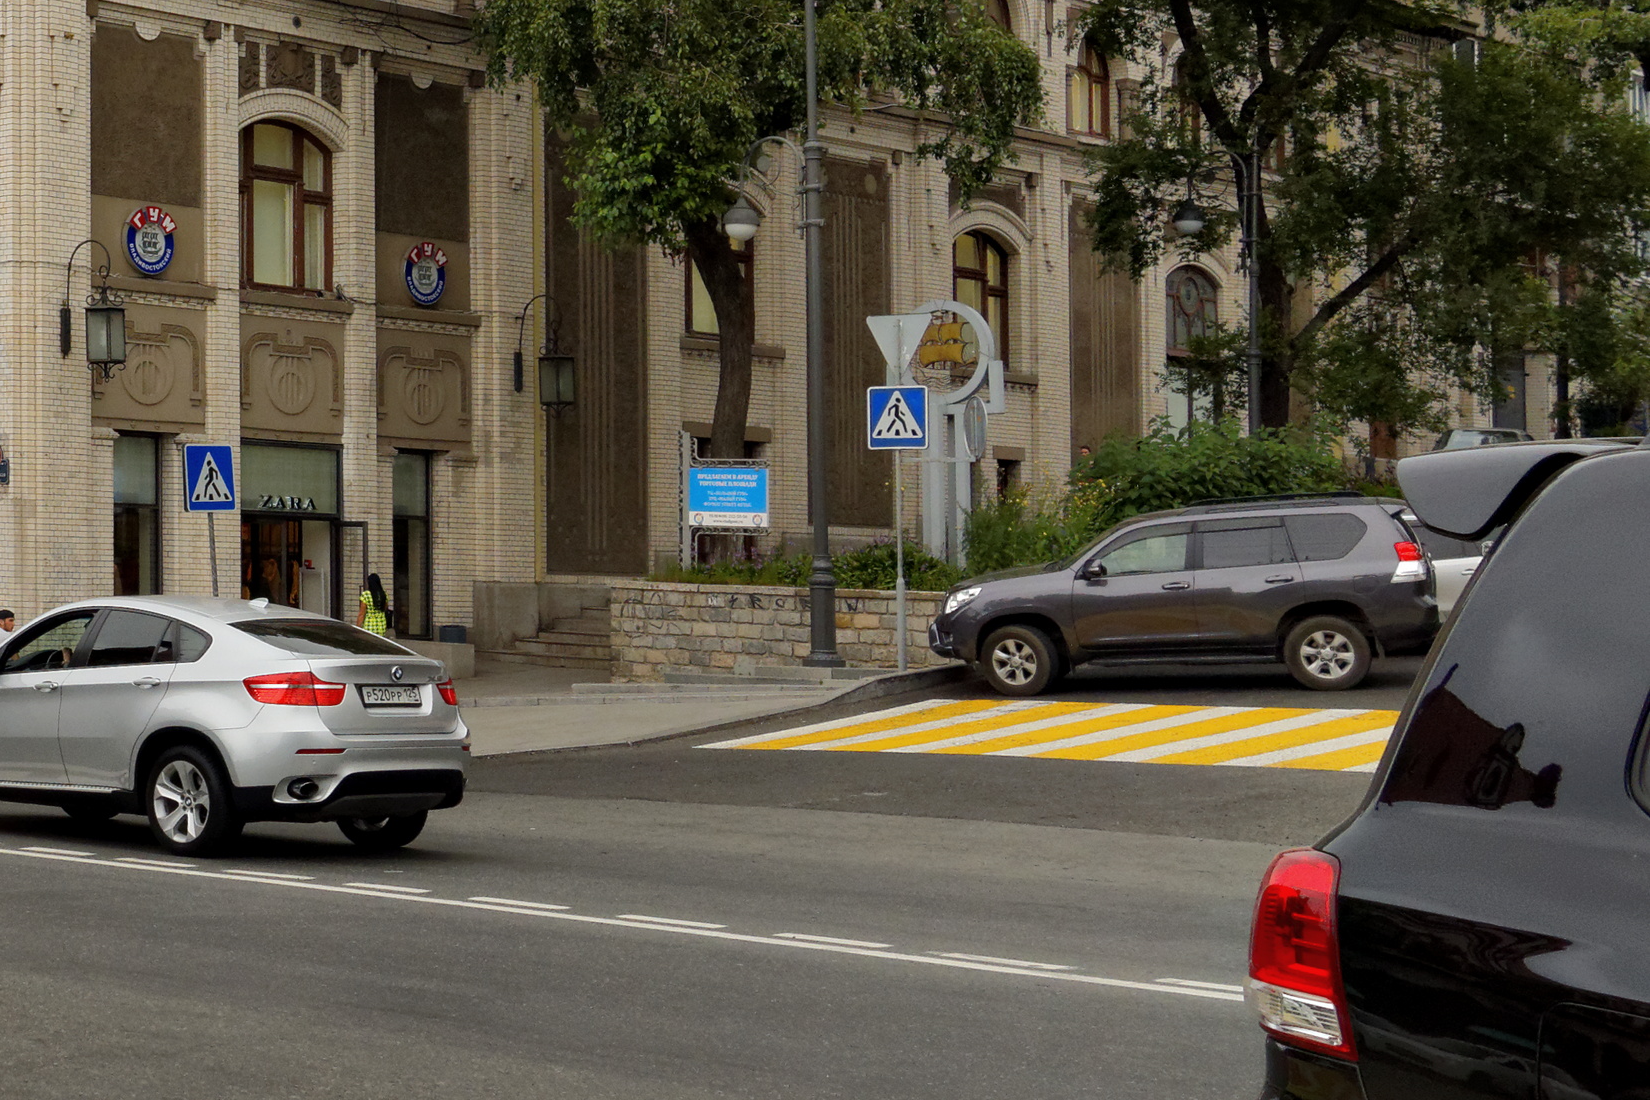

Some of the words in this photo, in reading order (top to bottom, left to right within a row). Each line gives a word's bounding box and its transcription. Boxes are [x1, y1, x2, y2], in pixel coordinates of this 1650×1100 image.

[133, 208, 176, 232] ГУМ
[410, 243, 448, 266] ГУМ
[258, 494, 317, 511] ZARA
[366, 688, 403, 701] Р520РР
[403, 688, 417, 698] 125
